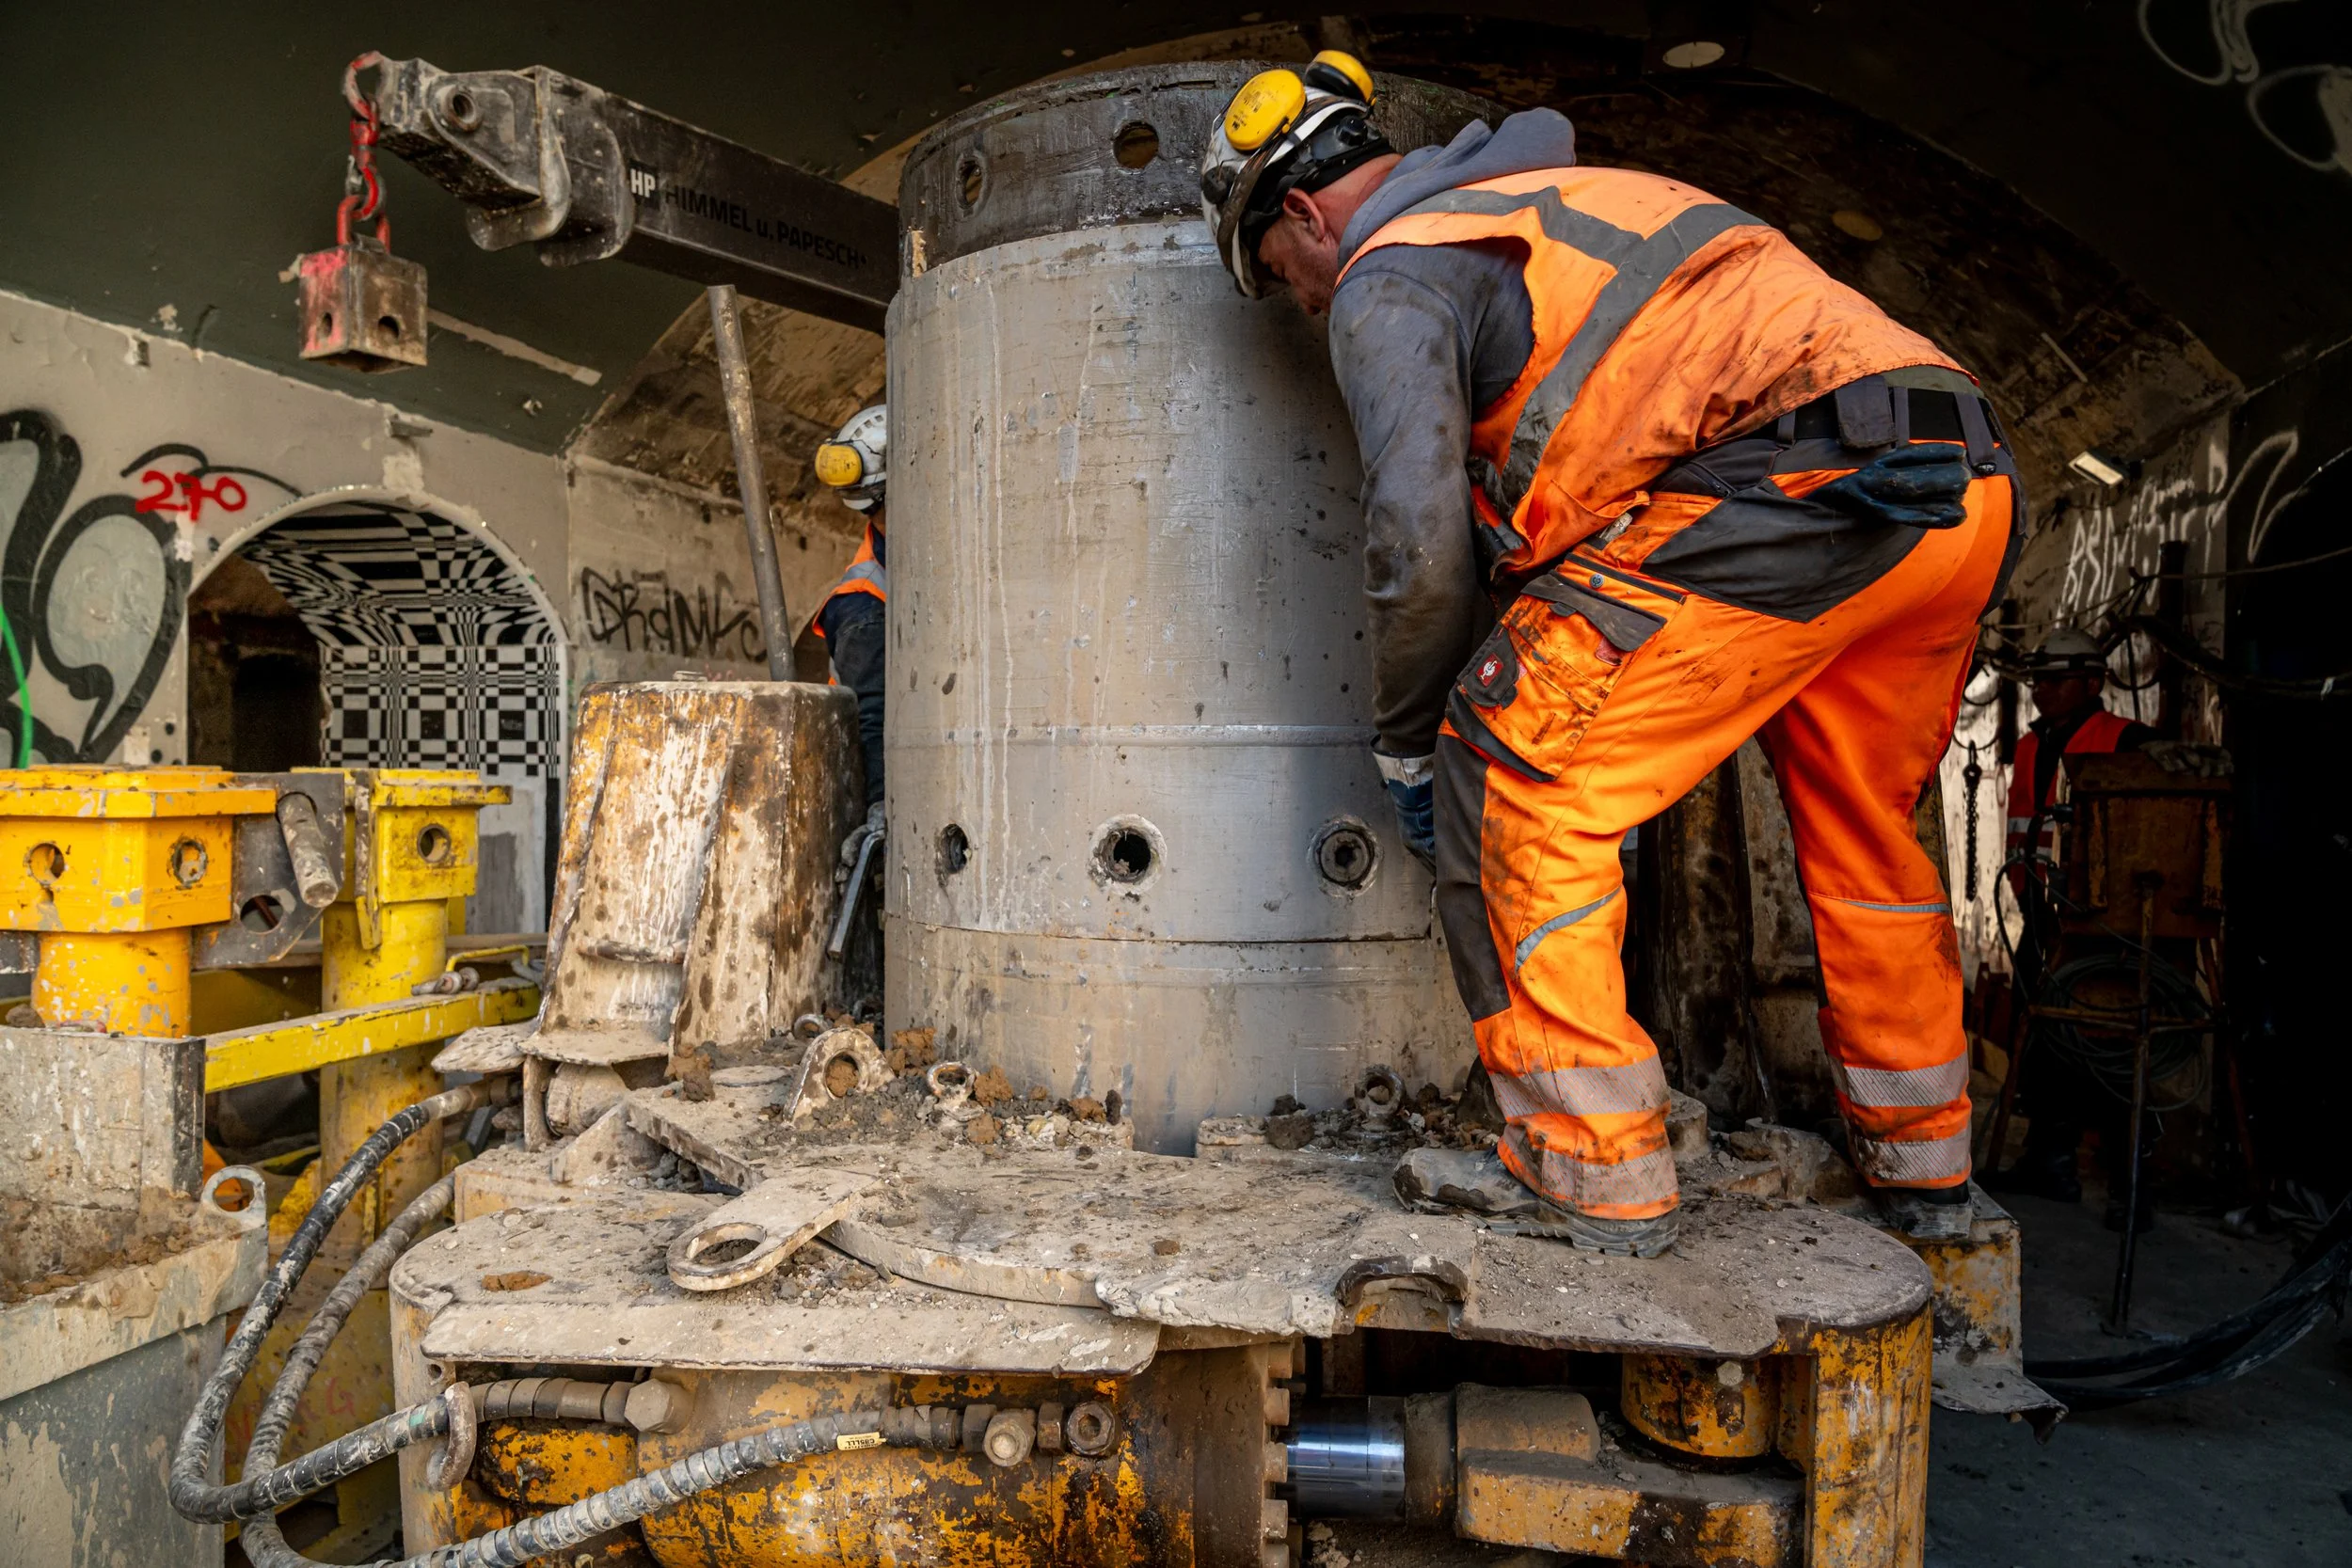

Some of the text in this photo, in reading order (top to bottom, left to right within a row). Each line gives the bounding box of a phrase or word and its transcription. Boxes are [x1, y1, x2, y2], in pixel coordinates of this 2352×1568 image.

[629, 167, 656, 198] HP
[664, 184, 753, 232] HIMMEL
[776, 220, 860, 270] PAPESCH
[135, 470, 246, 522] 270
